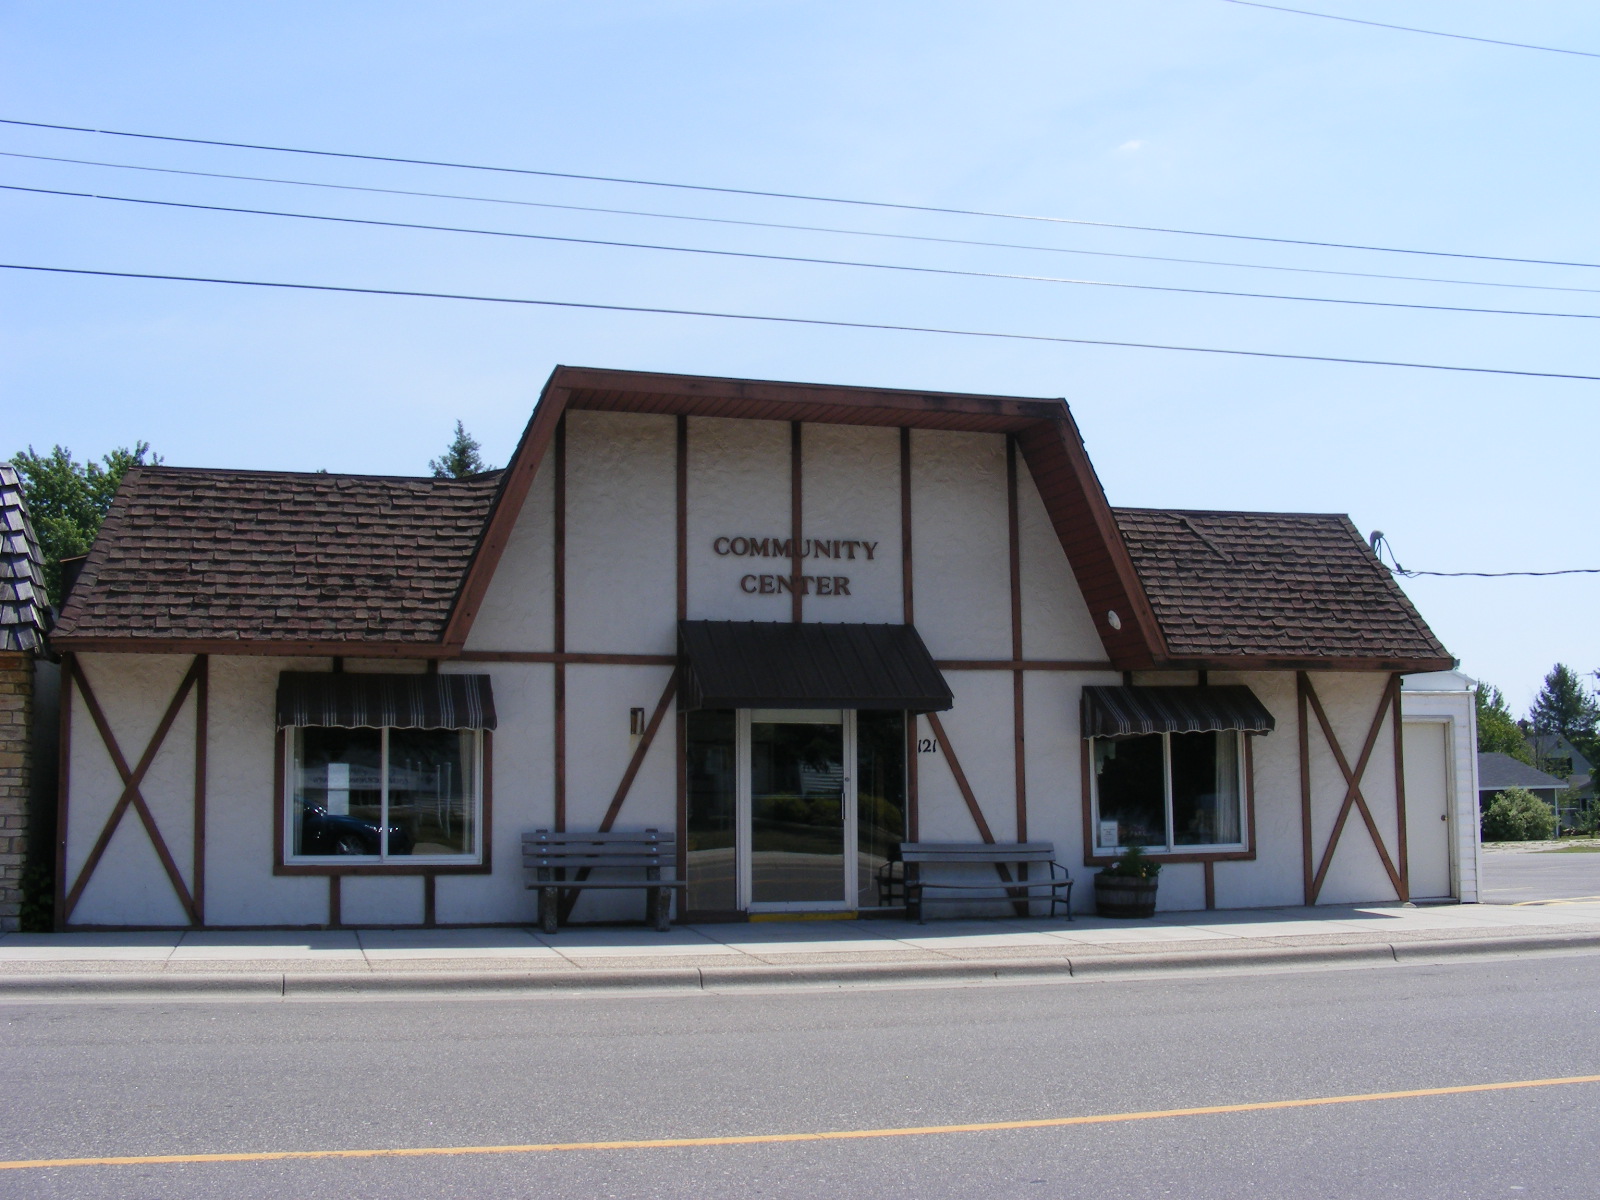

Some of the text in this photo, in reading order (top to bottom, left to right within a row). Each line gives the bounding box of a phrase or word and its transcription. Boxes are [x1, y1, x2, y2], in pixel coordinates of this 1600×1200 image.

[713, 536, 878, 560] COMMUNITY
[740, 574, 851, 596] CENTER
[917, 738, 937, 753] 121
